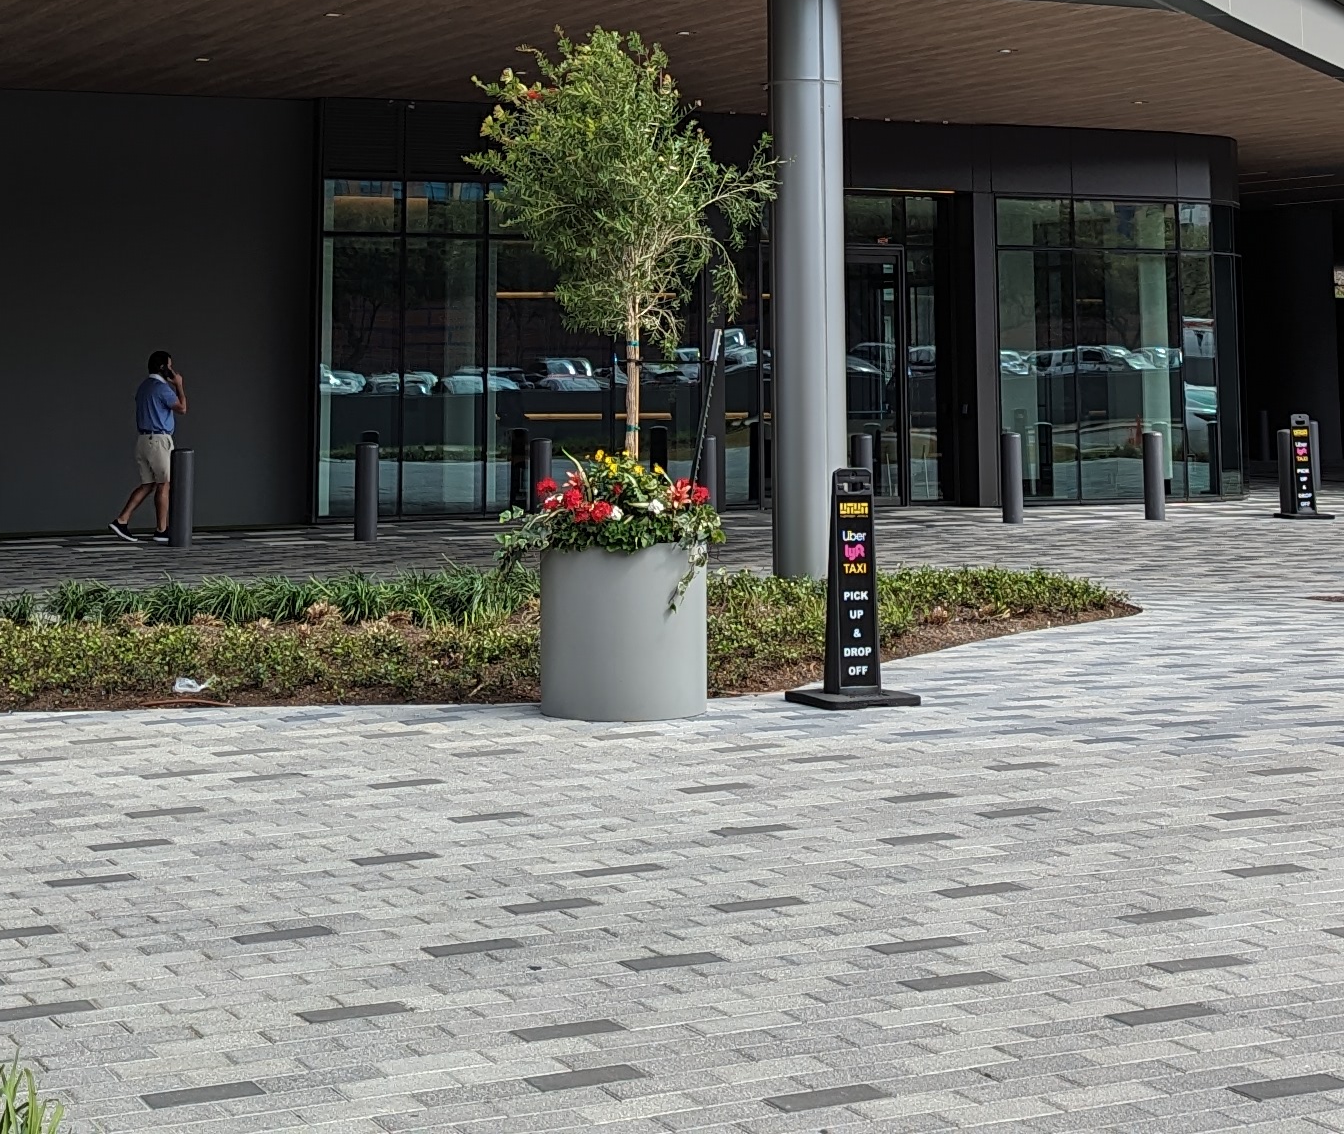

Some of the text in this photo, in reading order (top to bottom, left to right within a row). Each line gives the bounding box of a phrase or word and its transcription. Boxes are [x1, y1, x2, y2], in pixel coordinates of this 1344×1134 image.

[842, 530, 867, 542] Uber
[844, 543, 866, 561] lyft
[843, 563, 867, 574] TAXI
[843, 591, 869, 601] PICK
[849, 609, 864, 620] UP
[853, 628, 862, 638] &
[843, 647, 872, 657] DROP
[848, 666, 868, 676] OFF
